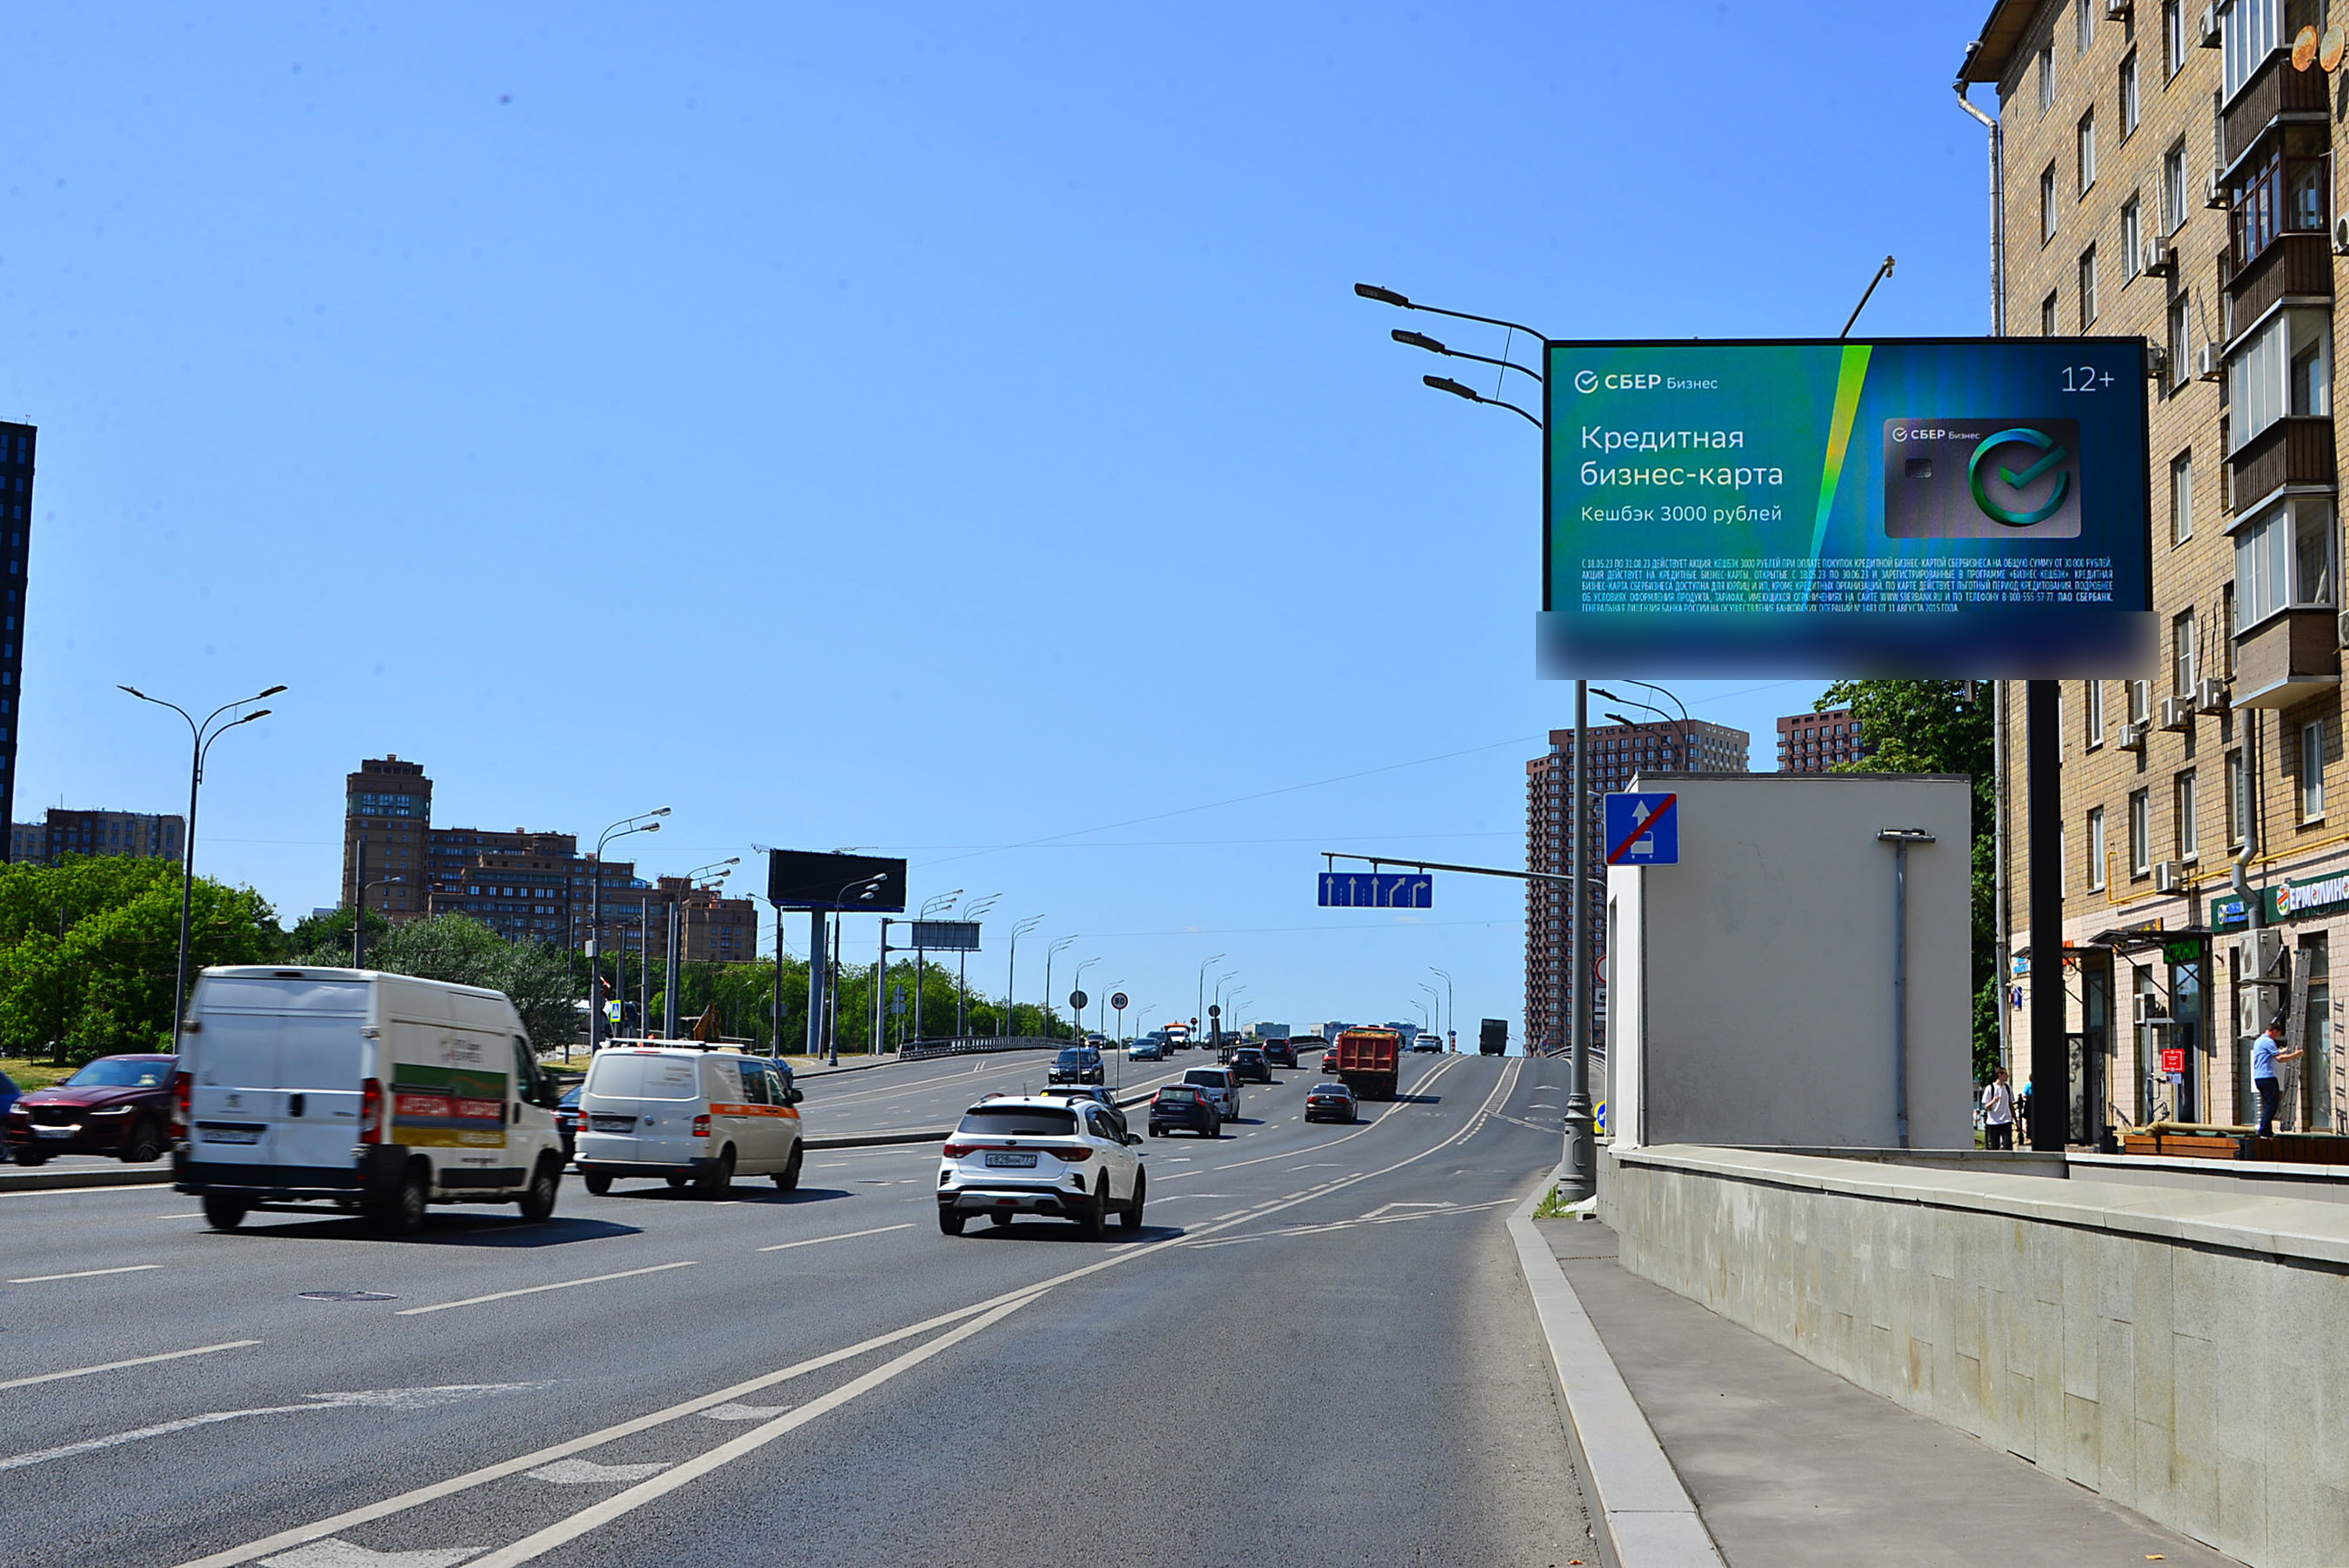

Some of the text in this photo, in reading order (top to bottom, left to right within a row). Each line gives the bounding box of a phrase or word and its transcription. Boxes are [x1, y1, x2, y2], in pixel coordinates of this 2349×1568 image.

[1605, 374, 1718, 390] СБЕР Бизнес
[2061, 366, 2115, 391] 12+
[1581, 425, 1744, 454] Кредитная
[1911, 429, 1980, 440] СБЕР Бизнес
[1580, 460, 1784, 490] бизнес-карта
[1581, 504, 1782, 524] Кешбэк 3000 рублей
[1114, 997, 1125, 1005] 80
